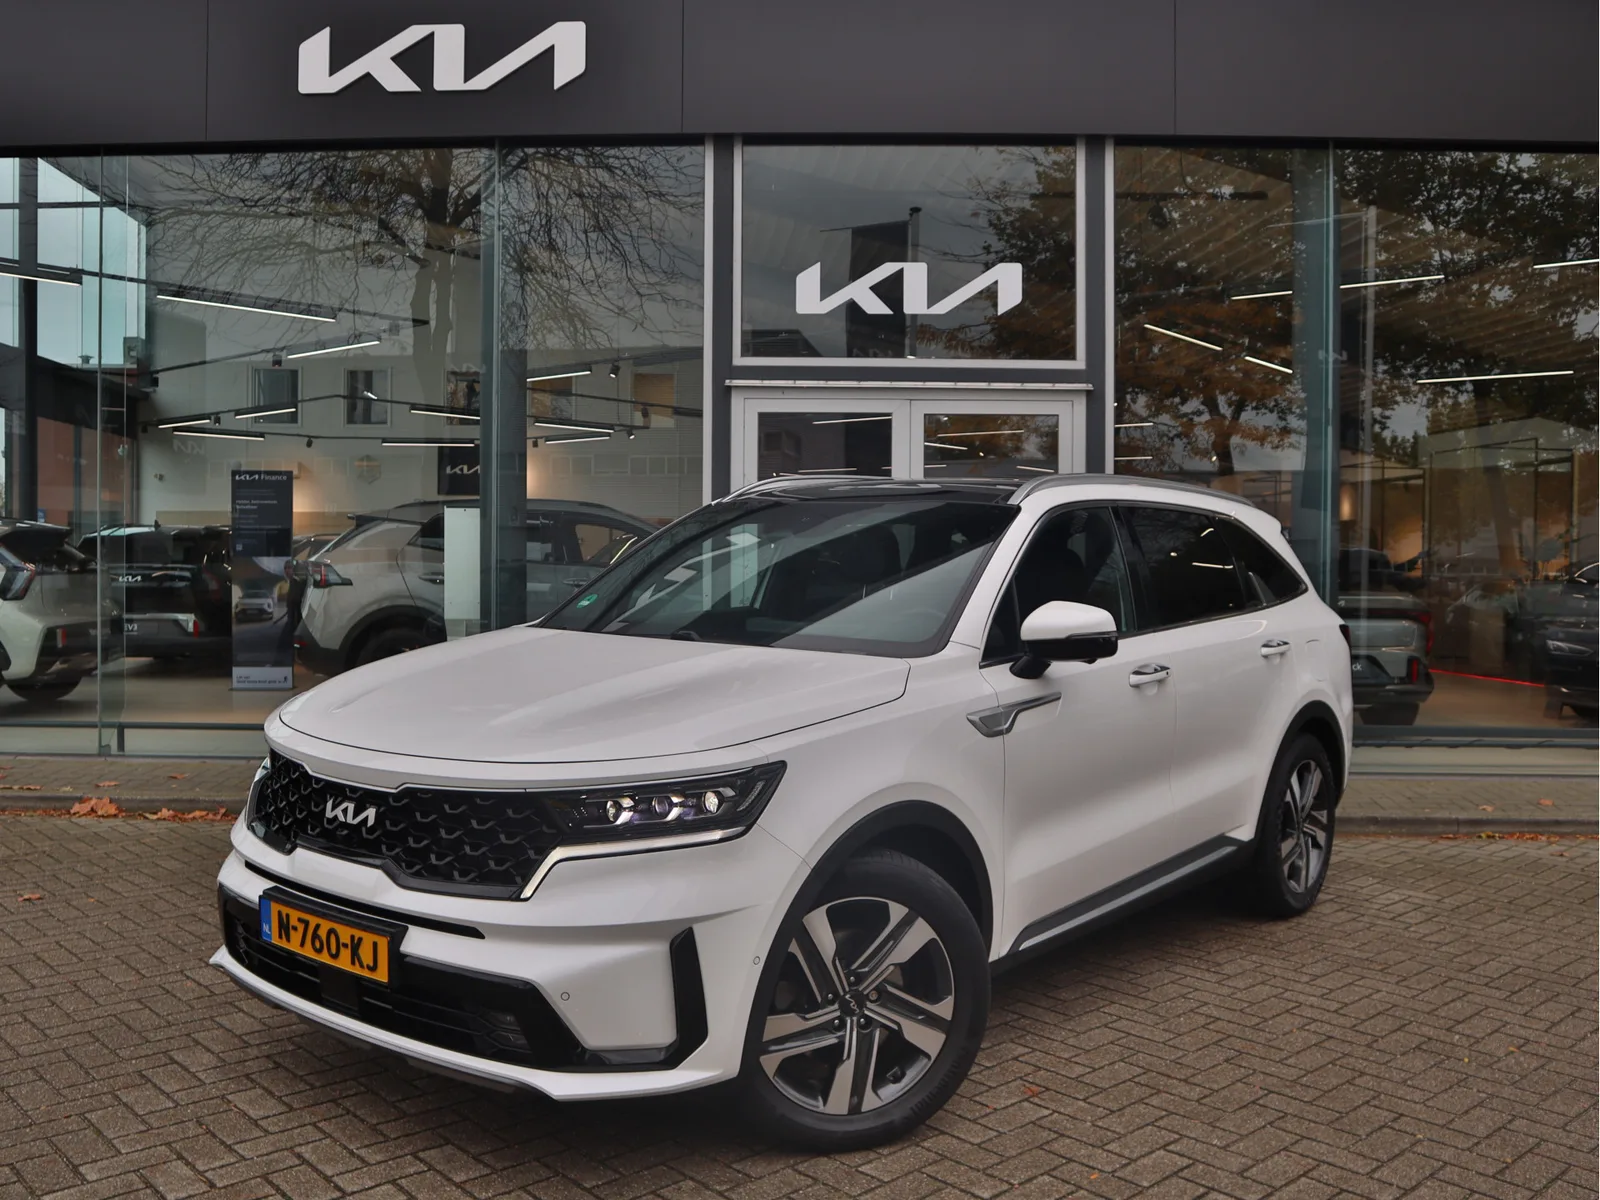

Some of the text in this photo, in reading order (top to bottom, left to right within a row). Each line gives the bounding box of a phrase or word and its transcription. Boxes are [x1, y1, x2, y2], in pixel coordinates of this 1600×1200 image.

[298, 21, 587, 94] KIA
[796, 261, 1023, 316] KIA
[446, 464, 481, 474] KIA
[325, 799, 377, 827] KIA
[262, 924, 271, 934] NL
[277, 909, 379, 972] N-760-KJ
